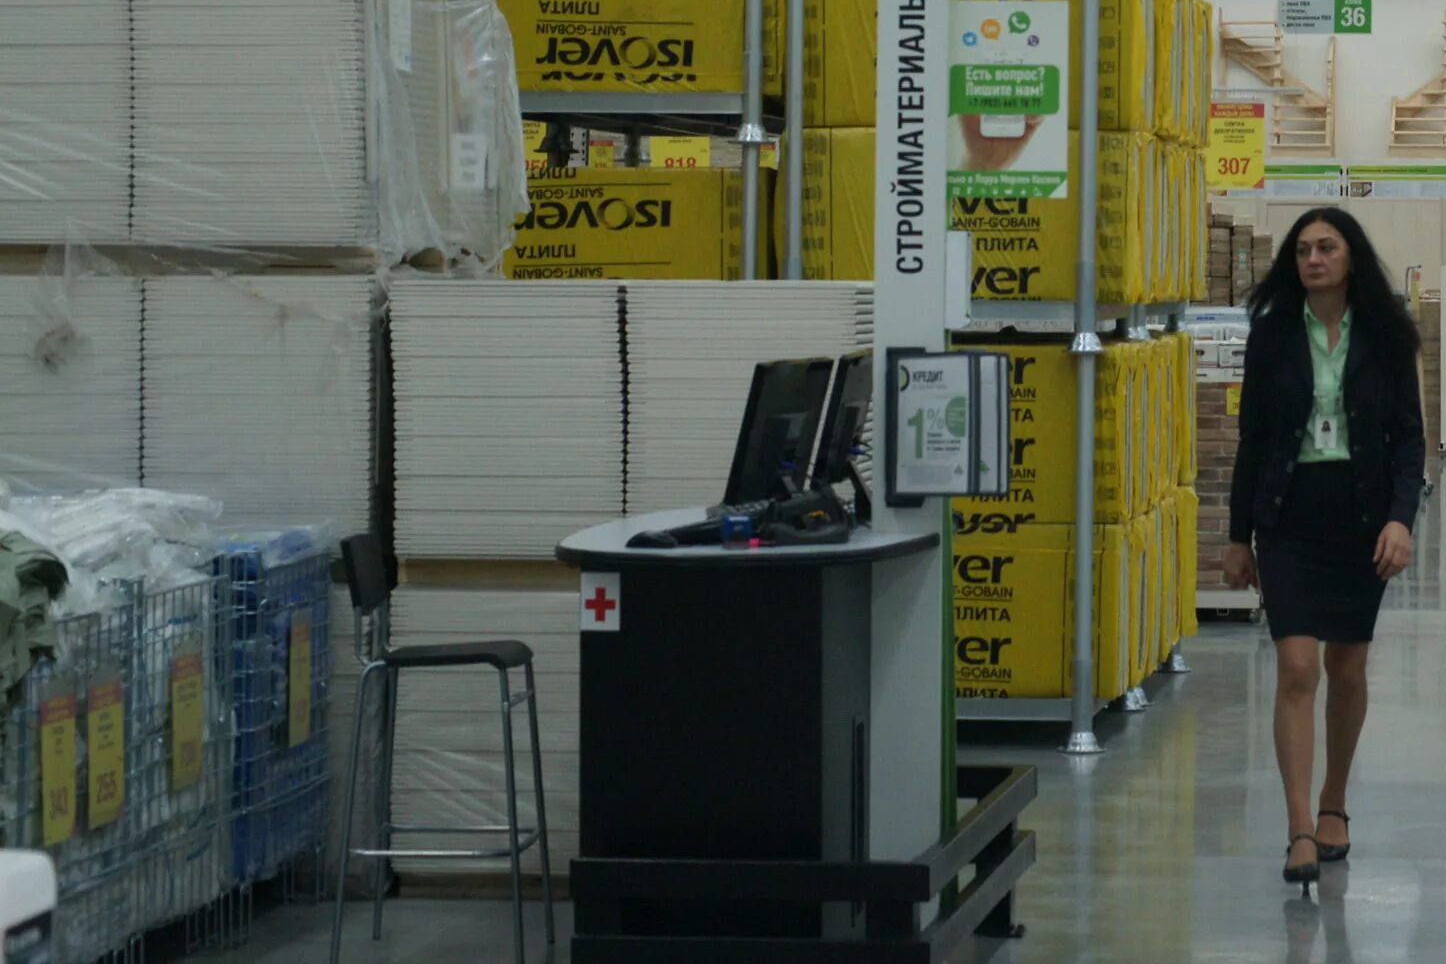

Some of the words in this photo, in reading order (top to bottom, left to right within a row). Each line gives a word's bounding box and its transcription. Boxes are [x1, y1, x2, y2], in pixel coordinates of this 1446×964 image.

[538, 0, 599, 15] ПЛИТА
[1341, 7, 1366, 27] 36
[537, 23, 627, 35] SAINT-GOBAIN
[966, 67, 992, 81] Есть
[995, 68, 1045, 83] вопрос?
[966, 82, 1012, 96] Пишите
[1015, 83, 1044, 96] нам!
[1218, 158, 1250, 175] 307
[528, 187, 603, 199] SAINT-GOBA
[976, 237, 1039, 251] ПЛИТА
[515, 244, 576, 259] ПЛИТА
[513, 267, 603, 278] SAINT-GOBAIN
[912, 370, 944, 382] КРЕДИТ
[955, 586, 1014, 598] -GOBAIN
[957, 668, 1012, 679] -GOBAIN
